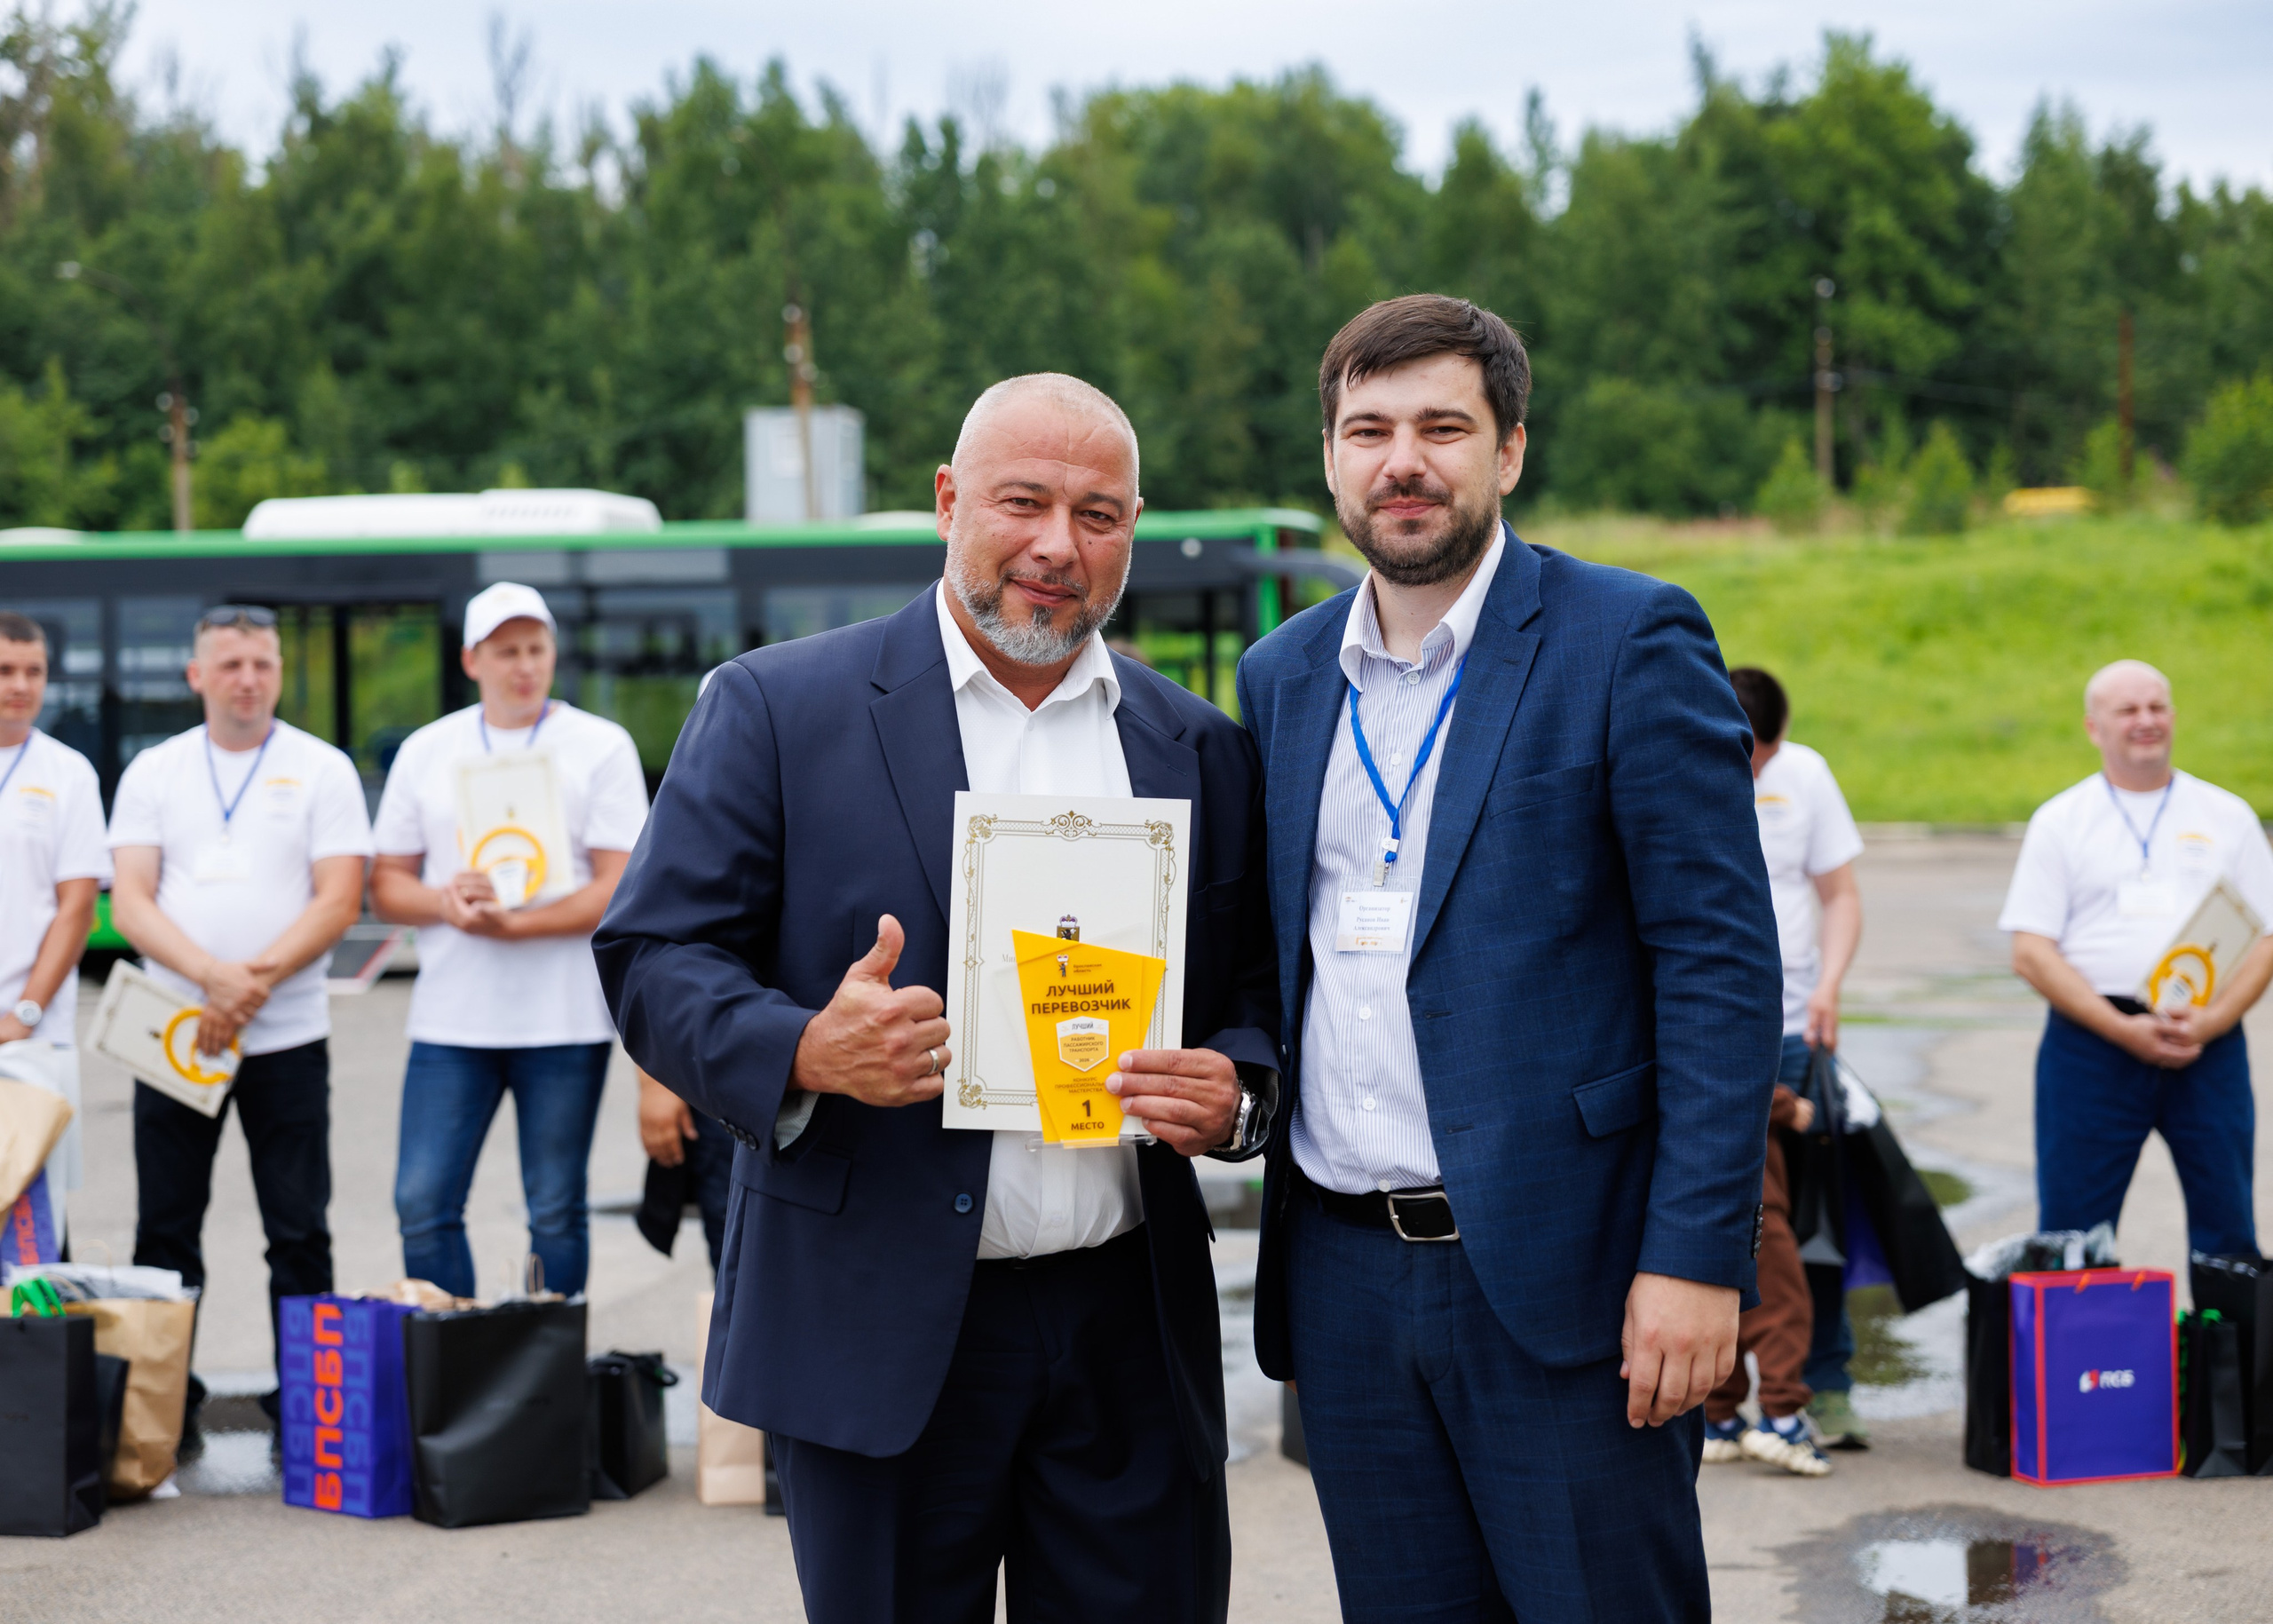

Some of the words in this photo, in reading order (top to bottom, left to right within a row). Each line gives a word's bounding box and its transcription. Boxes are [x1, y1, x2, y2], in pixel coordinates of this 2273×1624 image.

[1046, 979, 1114, 997] ЛУЧШИЙ
[1032, 998, 1131, 1015] ПЕРЕВОЗЧИК
[1072, 1021, 1094, 1030] ЛУЧШИЙ
[1081, 1099, 1091, 1117] 1
[1071, 1121, 1105, 1130] МЕСТО
